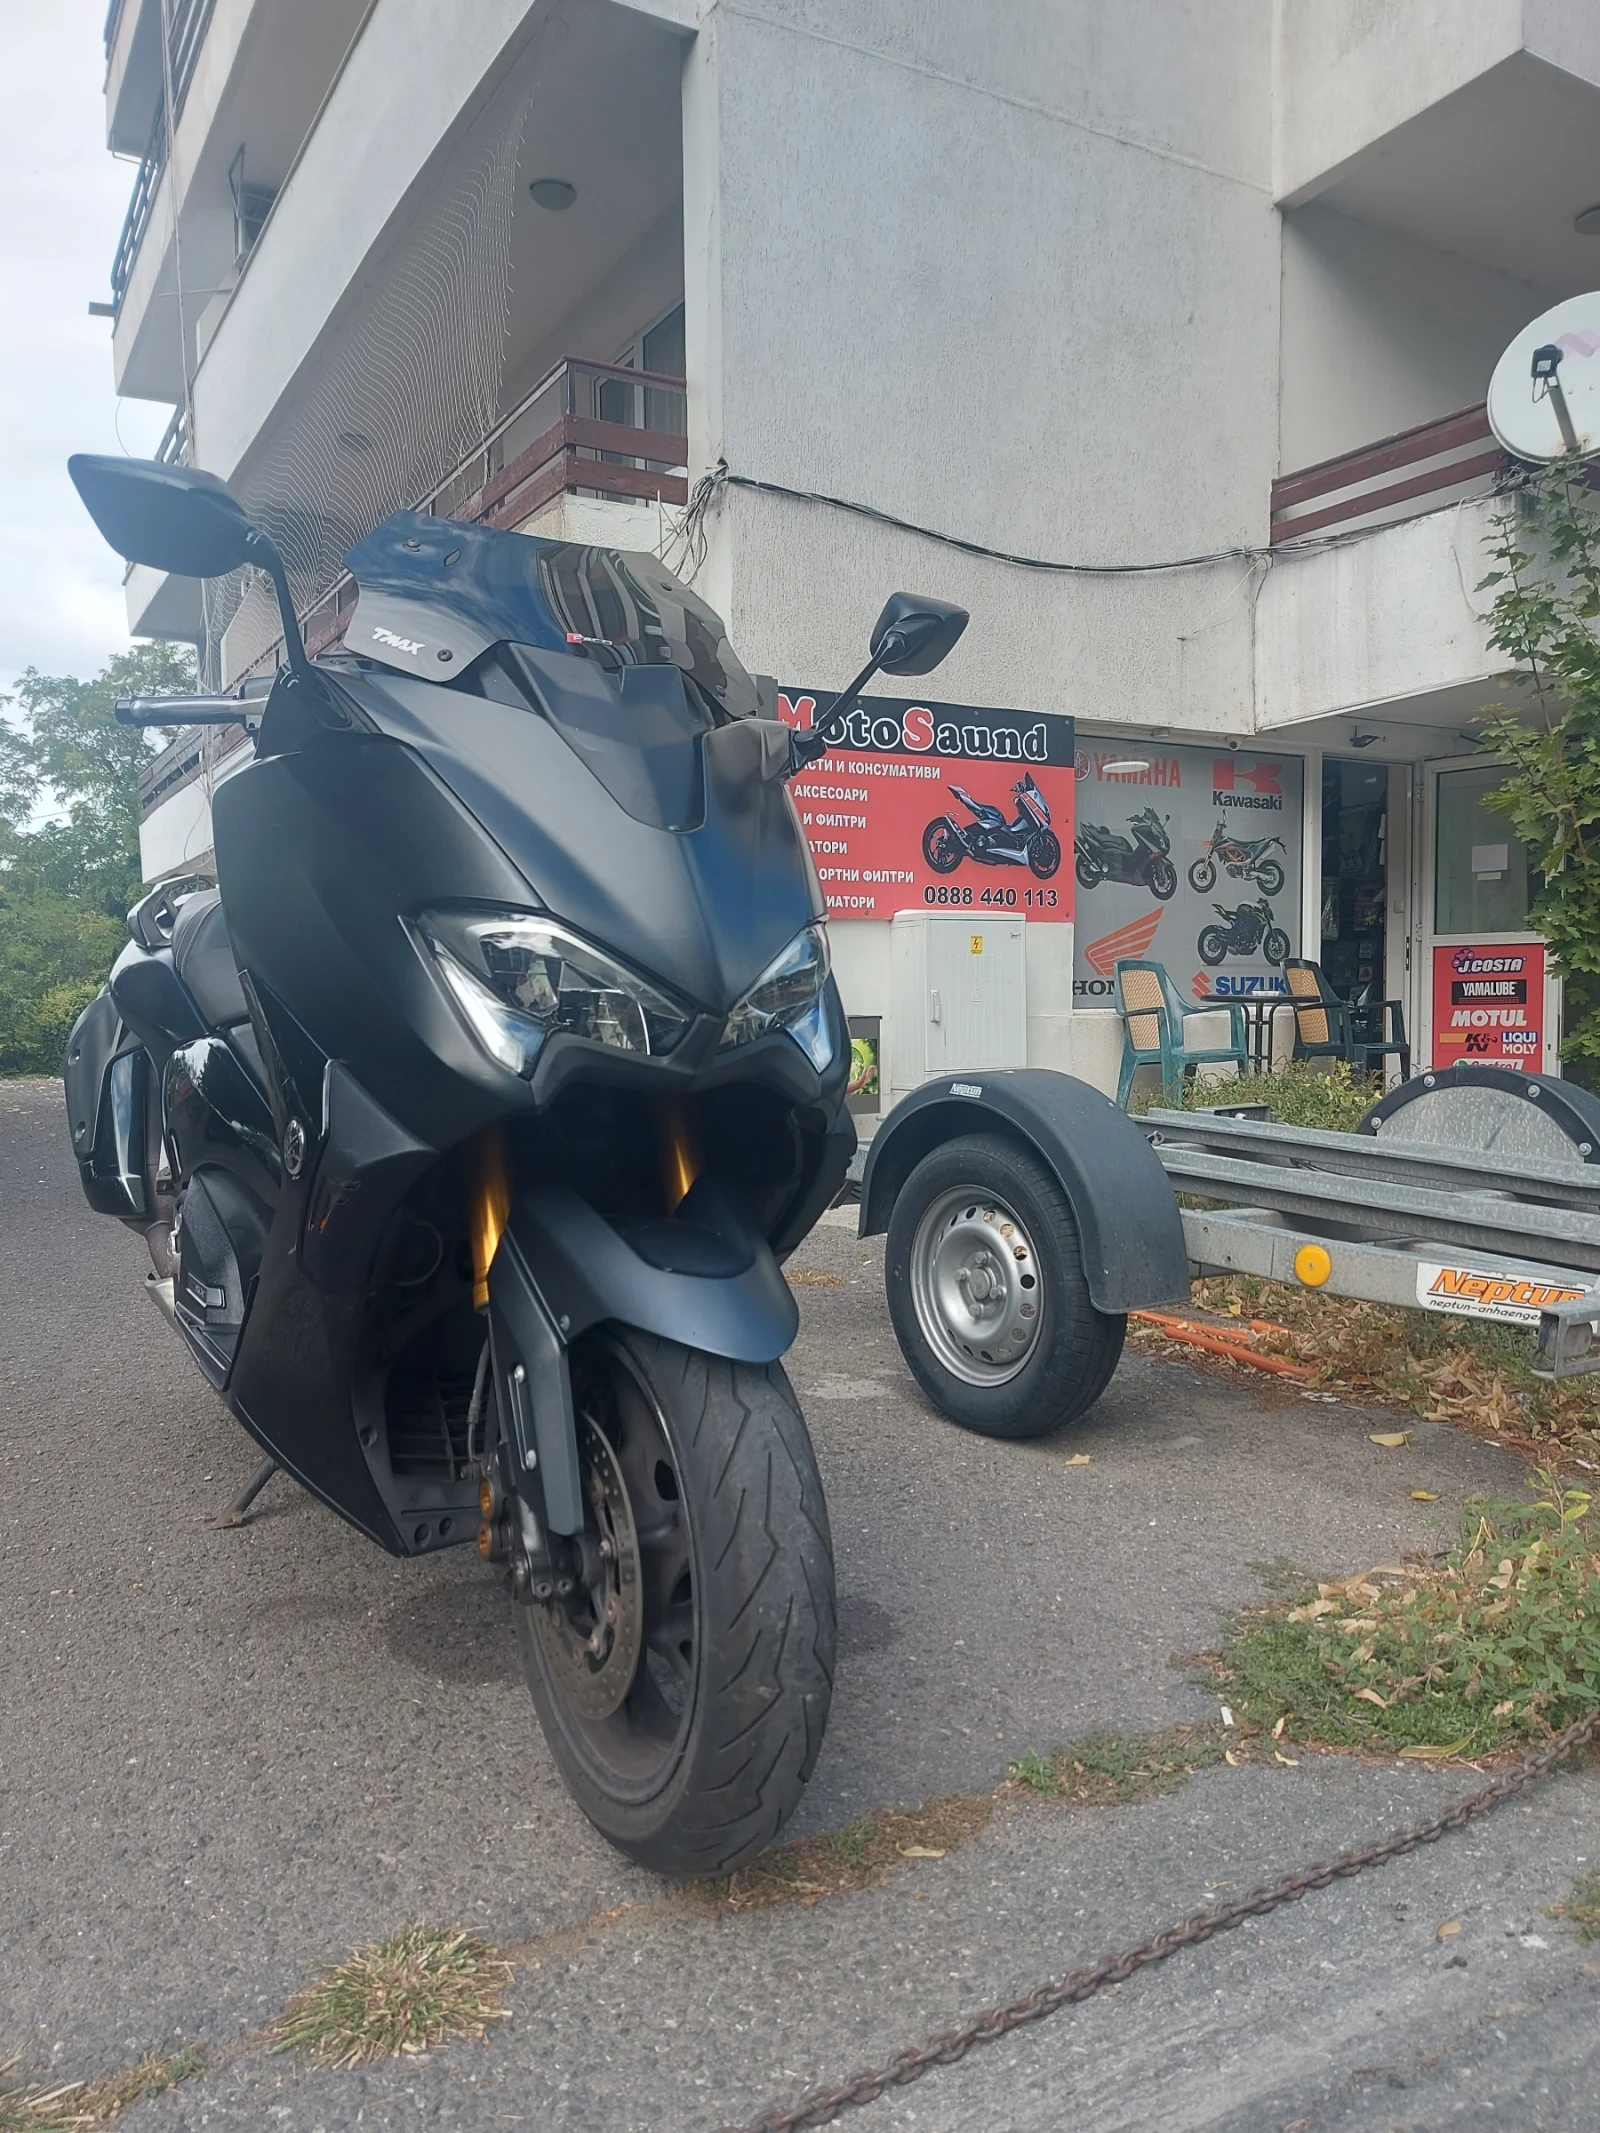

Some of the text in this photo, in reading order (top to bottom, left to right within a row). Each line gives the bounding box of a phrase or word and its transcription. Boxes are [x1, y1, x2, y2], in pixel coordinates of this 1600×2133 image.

[371, 627, 427, 656] TMAX
[777, 692, 1048, 761] MotoSaund
[836, 760, 845, 773] И
[848, 761, 941, 779] КОНСУМАТИВИ
[794, 784, 869, 801] АКСЕСОАРИ
[1212, 790, 1283, 811] Kawasaki
[803, 812, 867, 828] И ФИЛТРИ
[817, 867, 914, 883] ОРТНИ ФИЛТРИ
[824, 895, 876, 909] ИАТОРИ
[923, 885, 1059, 908] 0888 440 113
[1462, 981, 1516, 997] YAMALUBE
[1450, 1009, 1528, 1027] MOTUL
[1502, 1032, 1537, 1043] LIQUI
[1502, 1043, 1537, 1055] MOLY
[949, 1082, 983, 1098] Neptun
